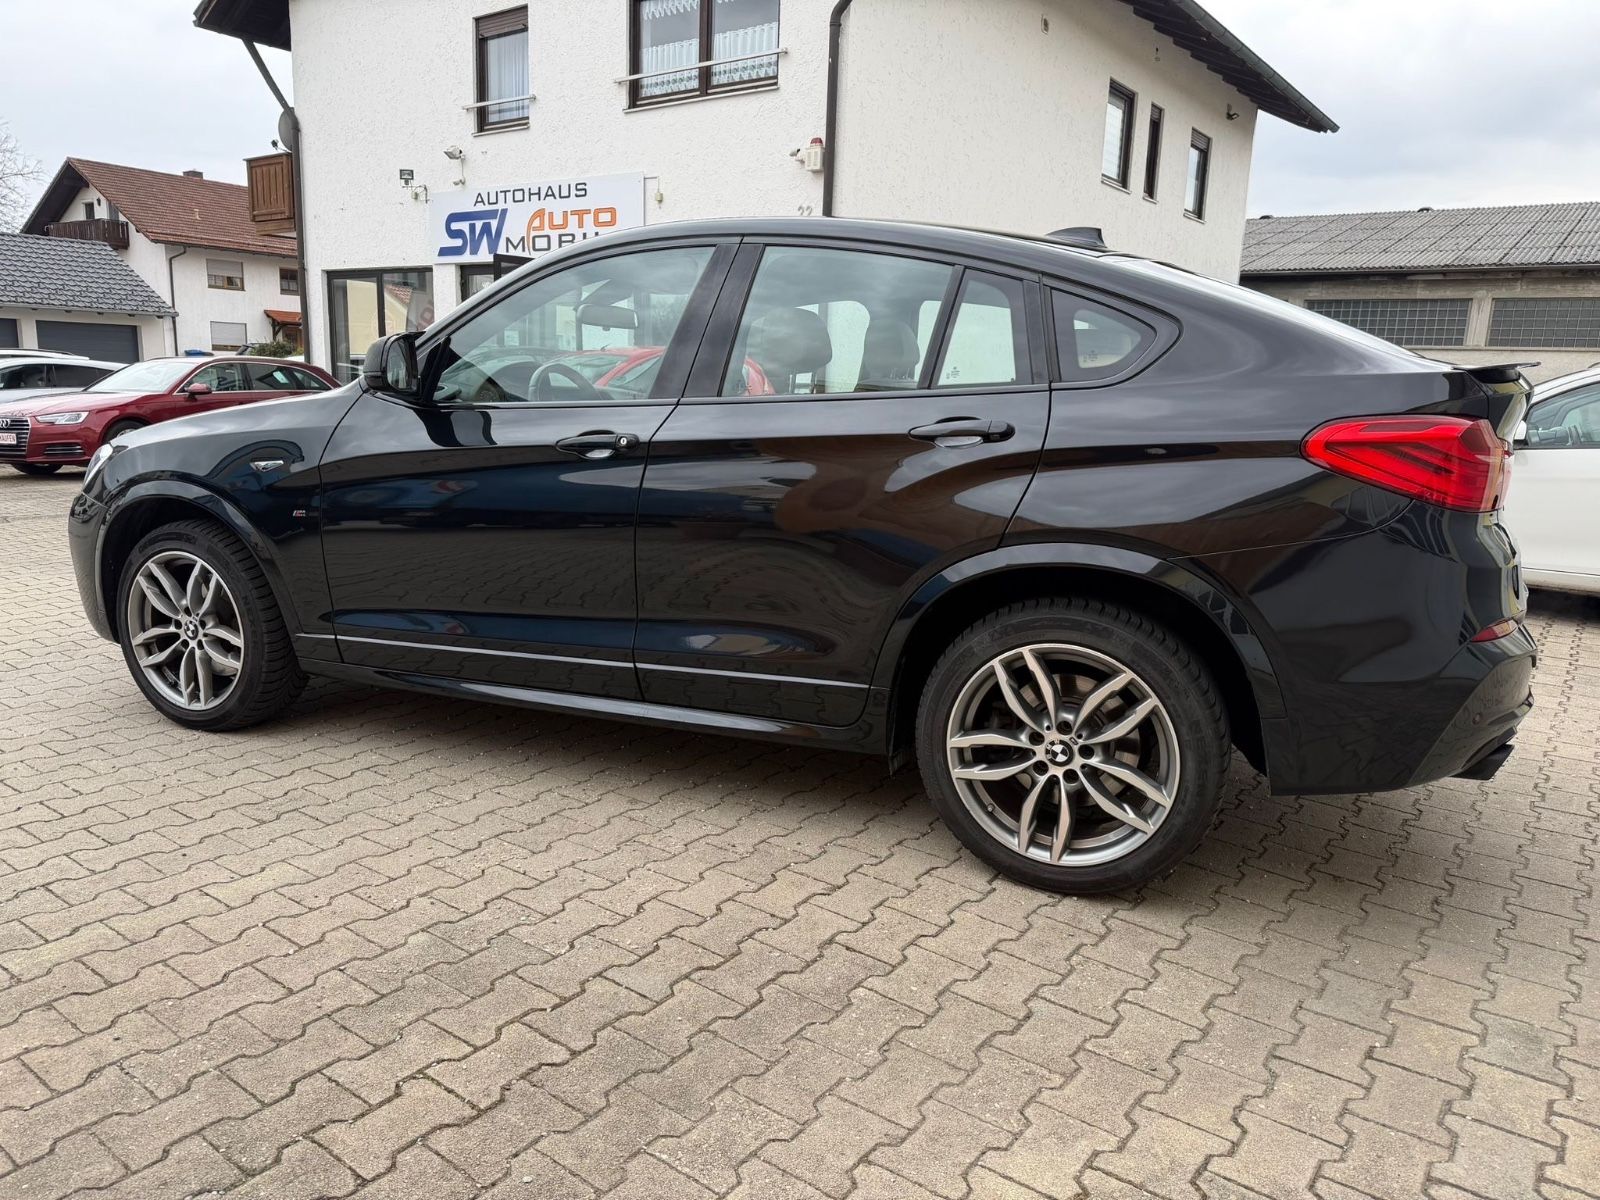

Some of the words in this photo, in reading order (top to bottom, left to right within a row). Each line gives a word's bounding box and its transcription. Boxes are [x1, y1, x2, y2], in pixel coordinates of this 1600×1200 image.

[473, 182, 588, 206] AUTOHAUS
[437, 208, 508, 256] SW
[505, 231, 599, 253] MOB
